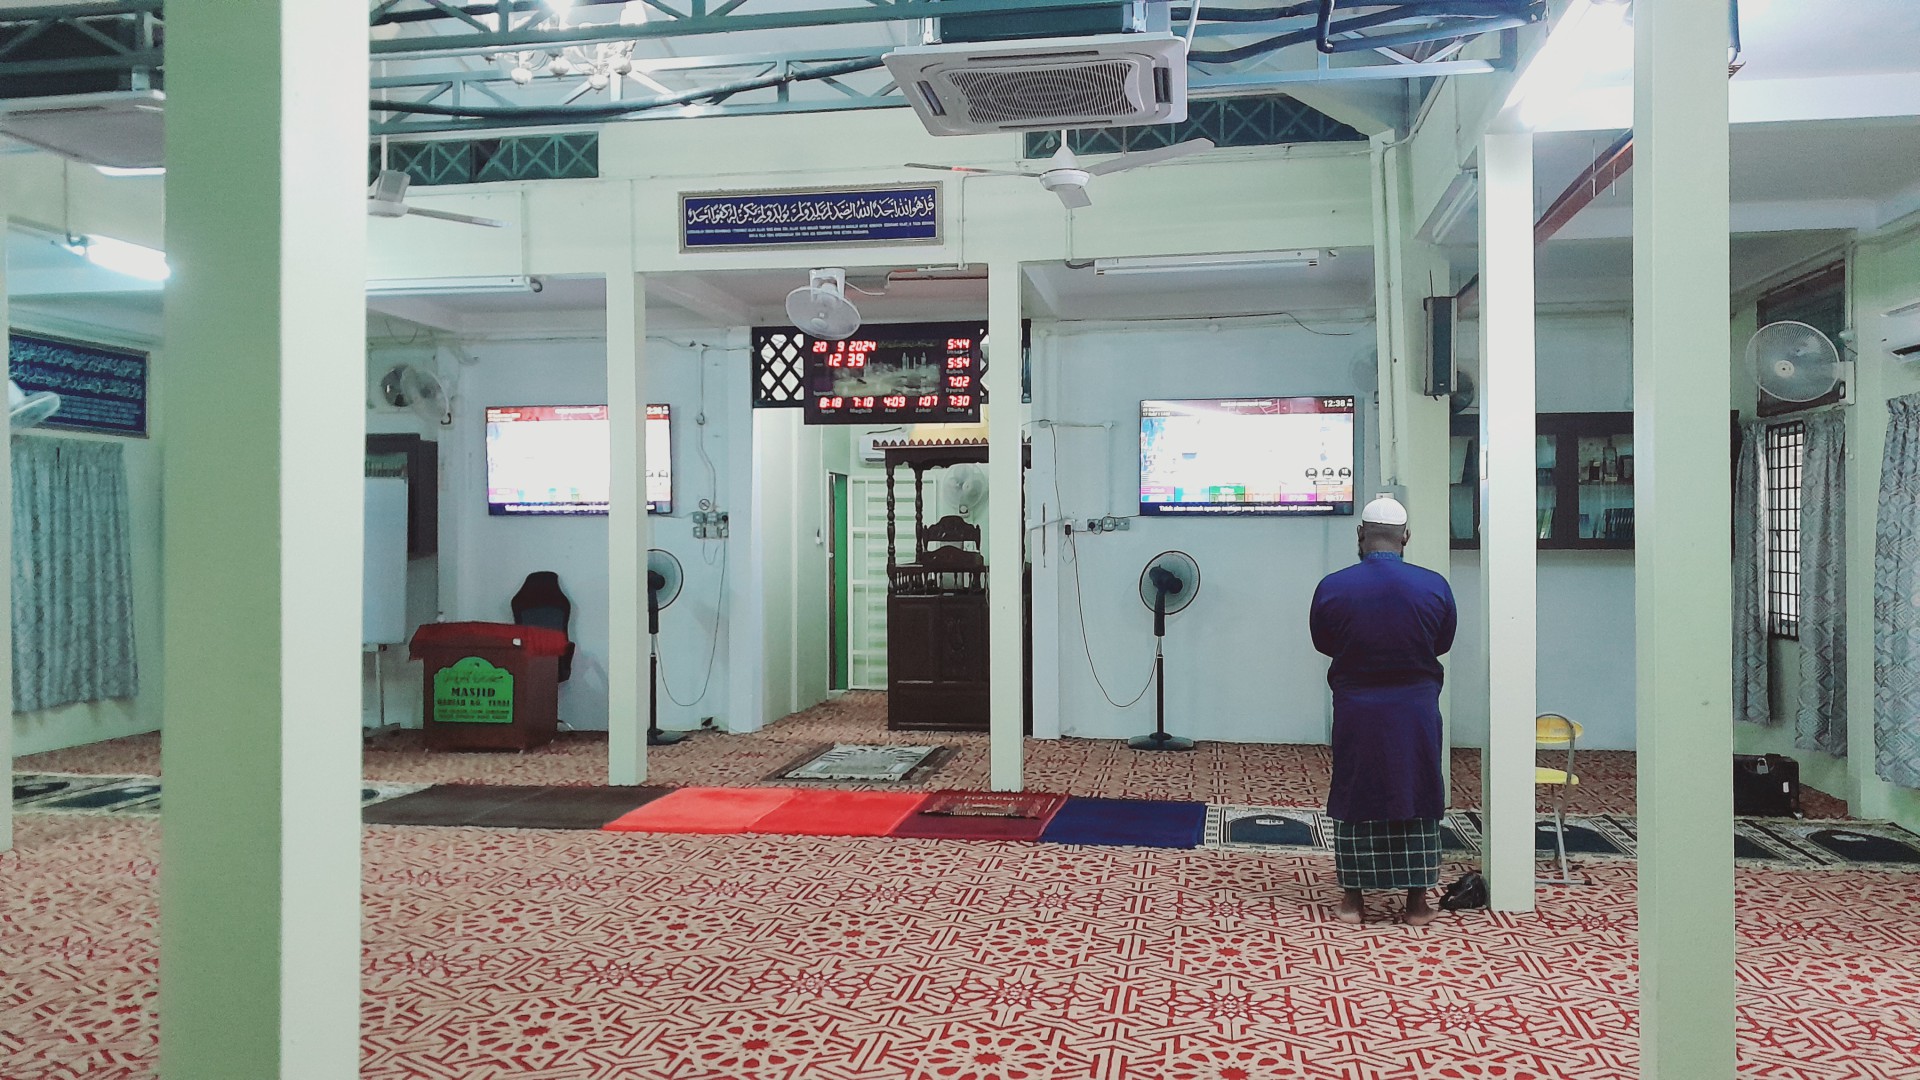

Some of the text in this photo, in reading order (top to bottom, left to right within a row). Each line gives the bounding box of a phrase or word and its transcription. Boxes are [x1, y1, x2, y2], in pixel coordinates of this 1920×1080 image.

[812, 341, 828, 353] 20
[837, 341, 845, 352] 9
[848, 340, 877, 352] 2024
[947, 338, 970, 349] 5:44
[947, 357, 970, 369] 5:54
[948, 376, 970, 387] 7:02
[819, 395, 970, 408] 8:18 7:10 4:09 1:07 7:30
[1323, 399, 1346, 408] 12:38
[451, 687, 496, 697] MASJID
